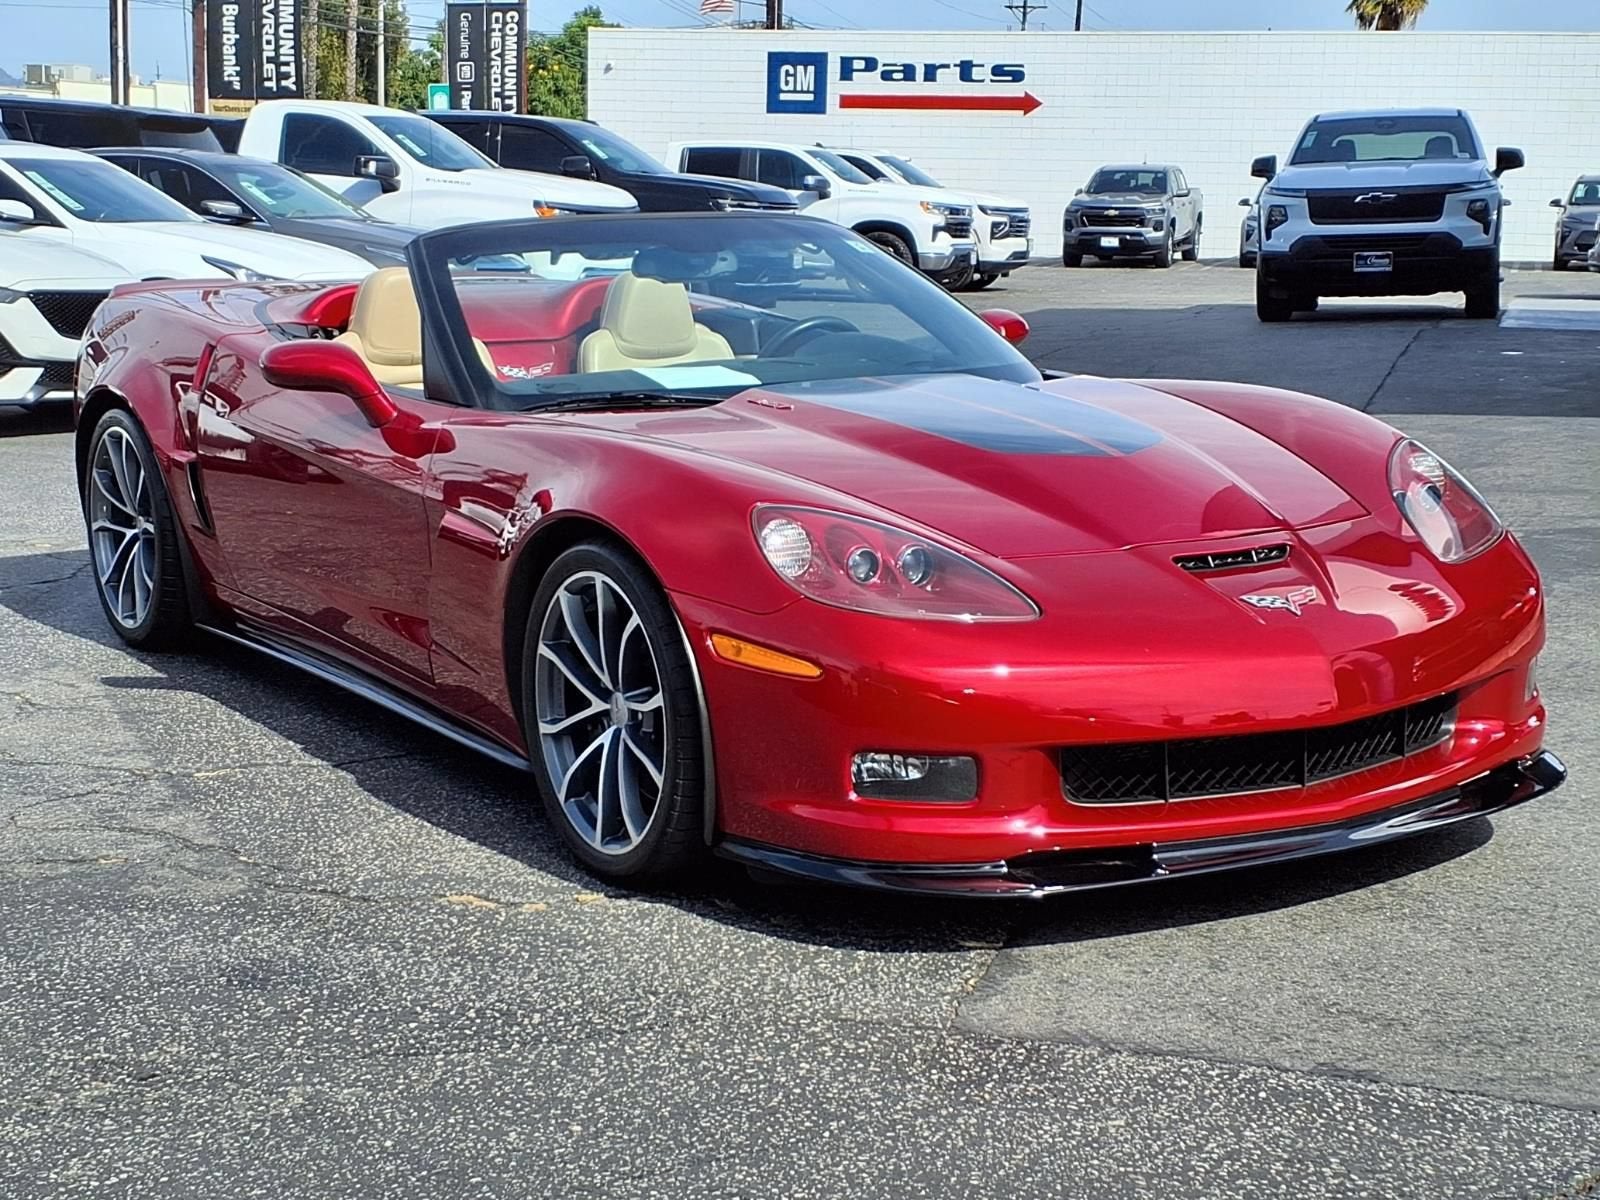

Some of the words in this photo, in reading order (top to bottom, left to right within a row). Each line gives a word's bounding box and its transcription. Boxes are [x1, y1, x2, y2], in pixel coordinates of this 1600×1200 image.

[262, 0, 277, 92] VROLET
[279, 0, 296, 92] MUNITY
[460, 12, 472, 59] Genuine
[490, 11, 503, 112] CHEVROLE
[779, 64, 815, 92] GM
[839, 56, 1026, 83] Parts
